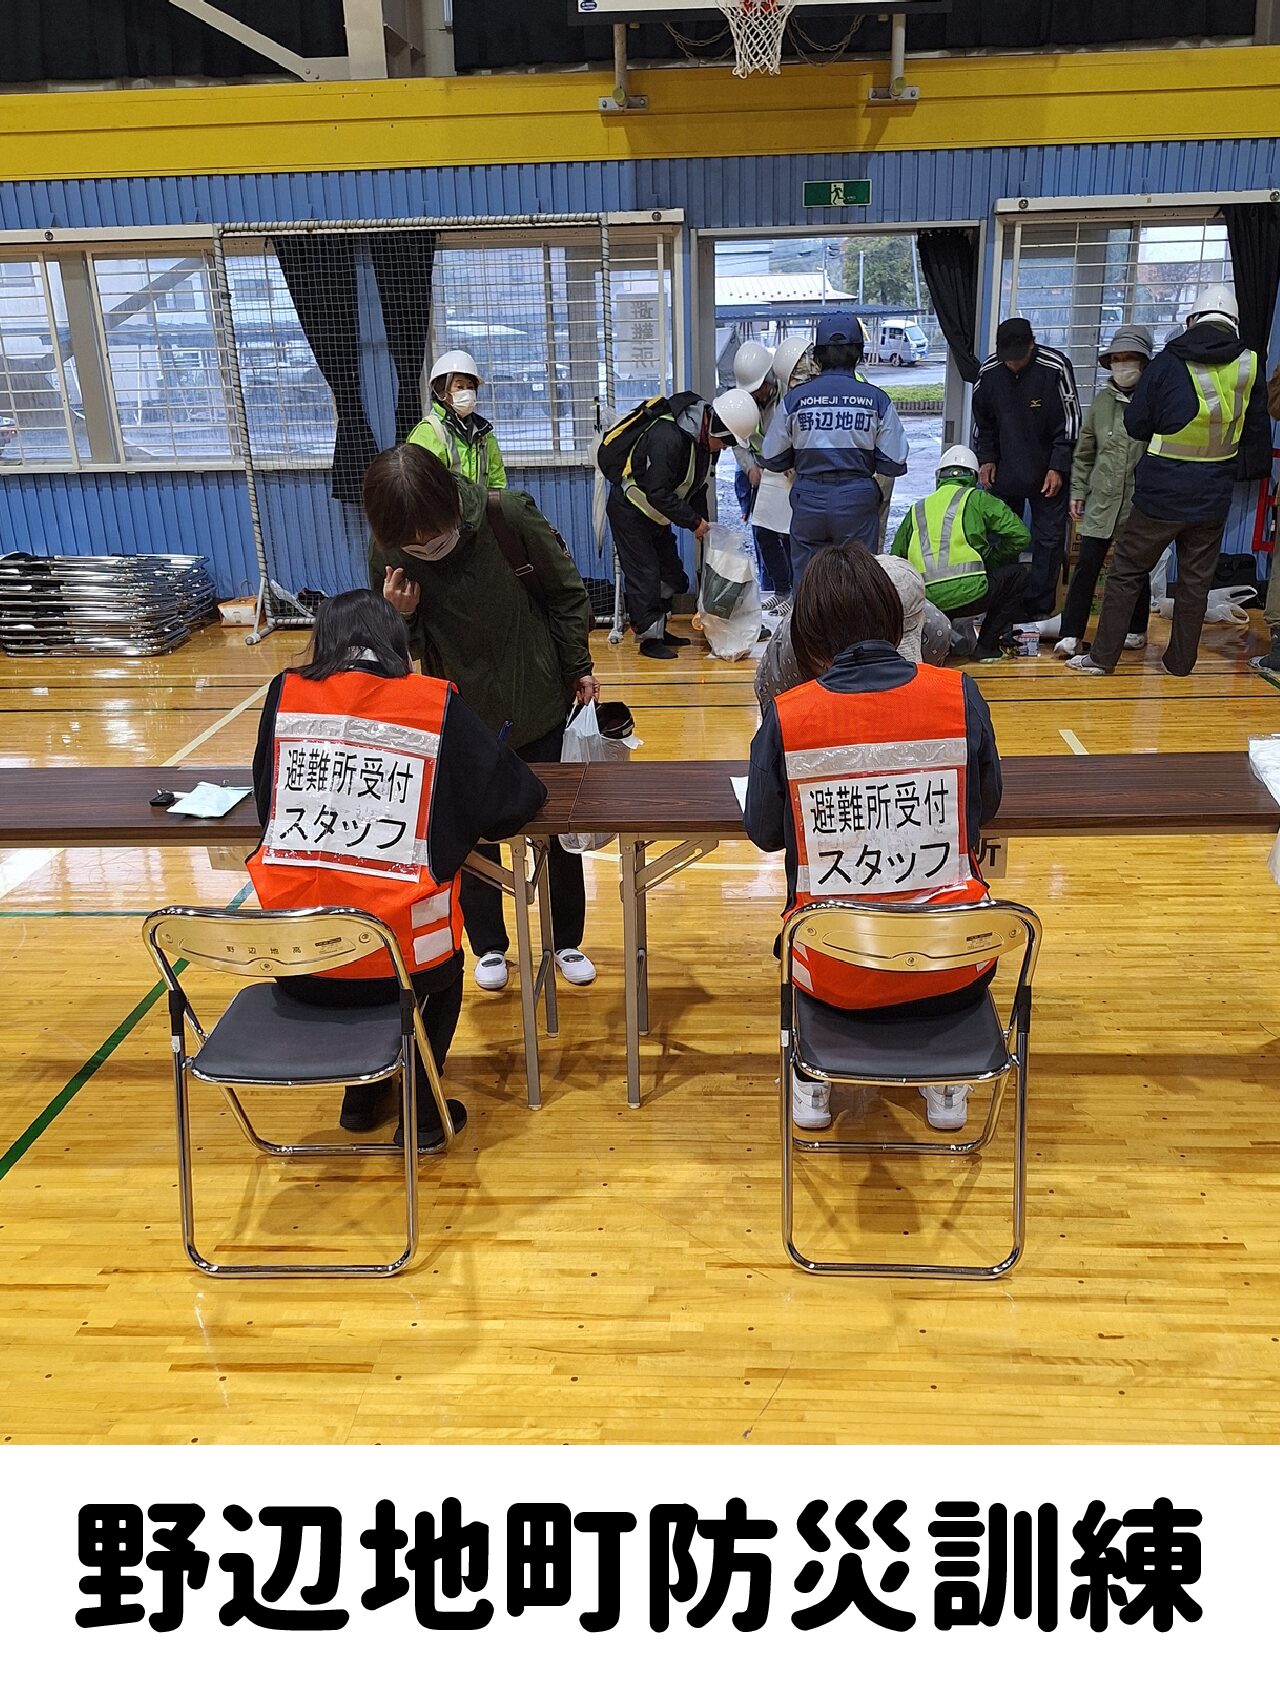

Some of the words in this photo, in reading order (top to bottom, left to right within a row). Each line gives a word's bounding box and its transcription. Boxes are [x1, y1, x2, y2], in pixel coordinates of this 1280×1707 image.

[797, 411, 874, 432] 野辺地町
[800, 395, 838, 407] NOHEJI
[842, 395, 873, 407] TOWN
[284, 747, 414, 804] 避難所受付
[279, 804, 407, 850] スタッフ
[809, 778, 949, 834] 避難所受付
[817, 842, 951, 886] スタッフ
